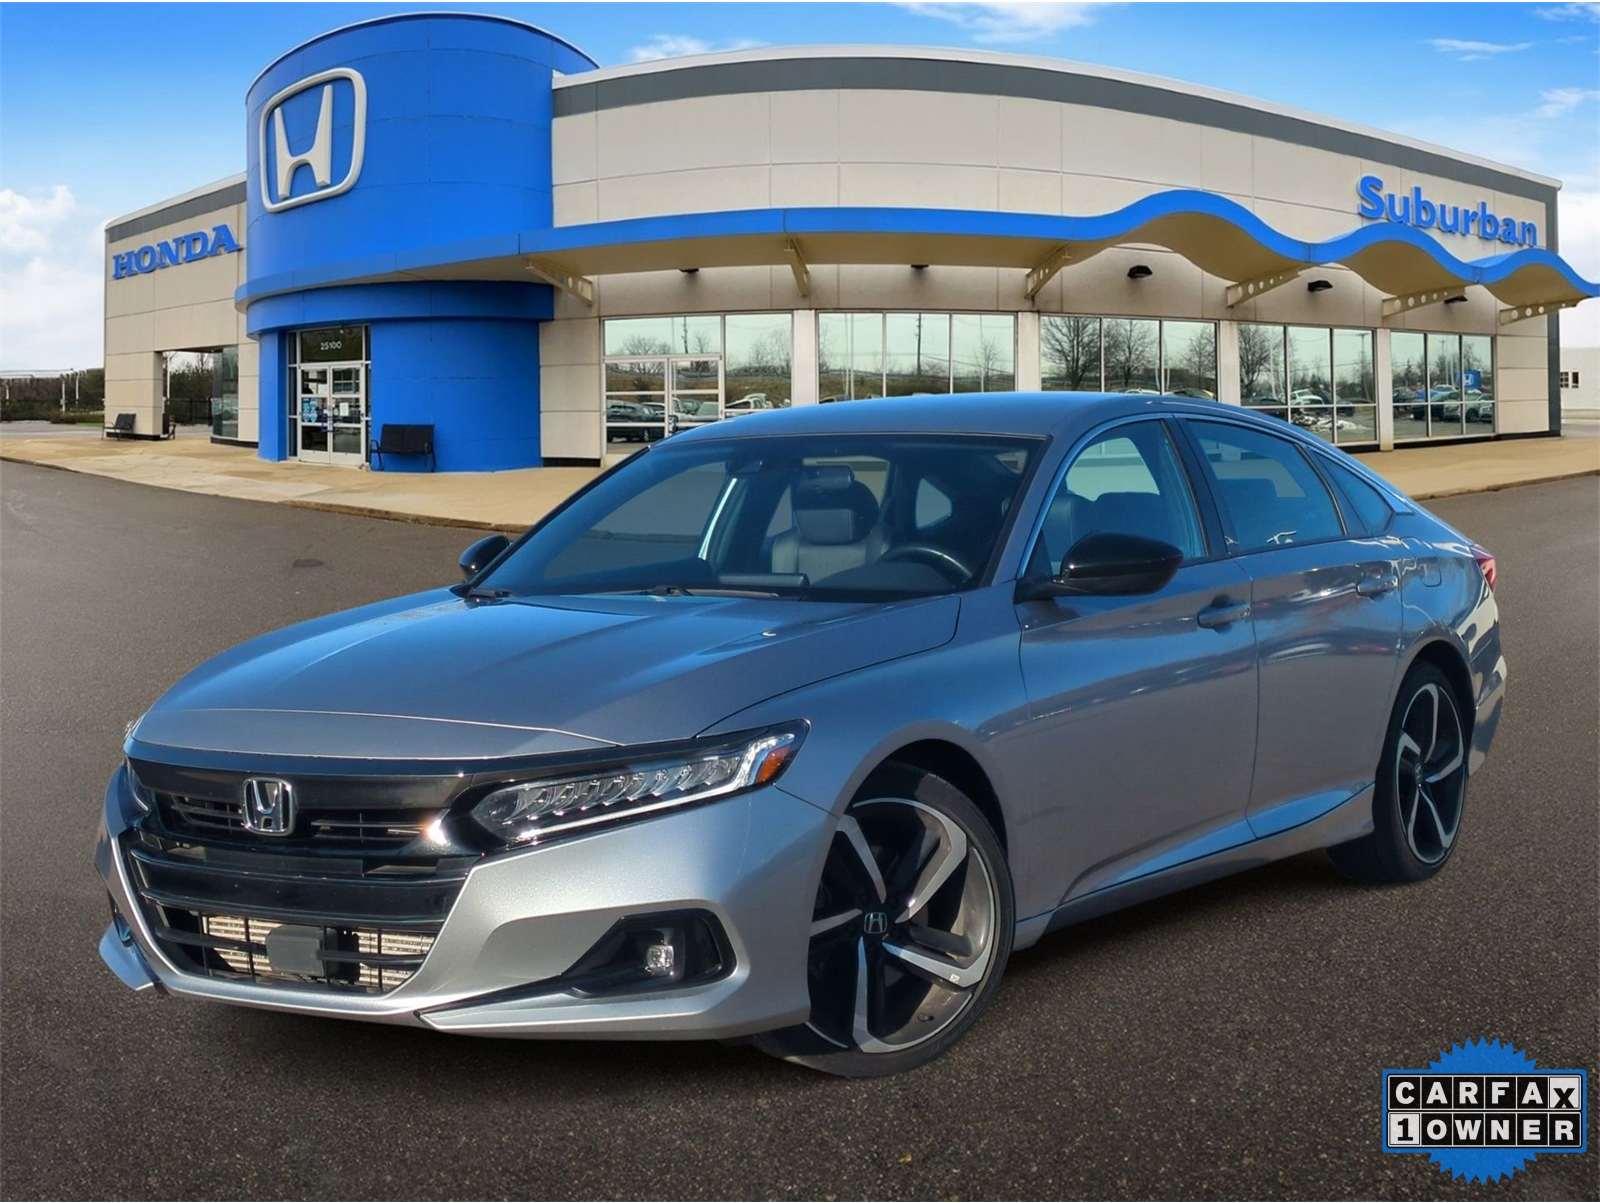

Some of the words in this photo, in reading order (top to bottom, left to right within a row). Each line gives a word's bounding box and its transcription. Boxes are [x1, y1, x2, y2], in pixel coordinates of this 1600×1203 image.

[1358, 175, 1538, 248] Suburban
[112, 224, 241, 280] HONDA
[320, 340, 342, 350] 25100
